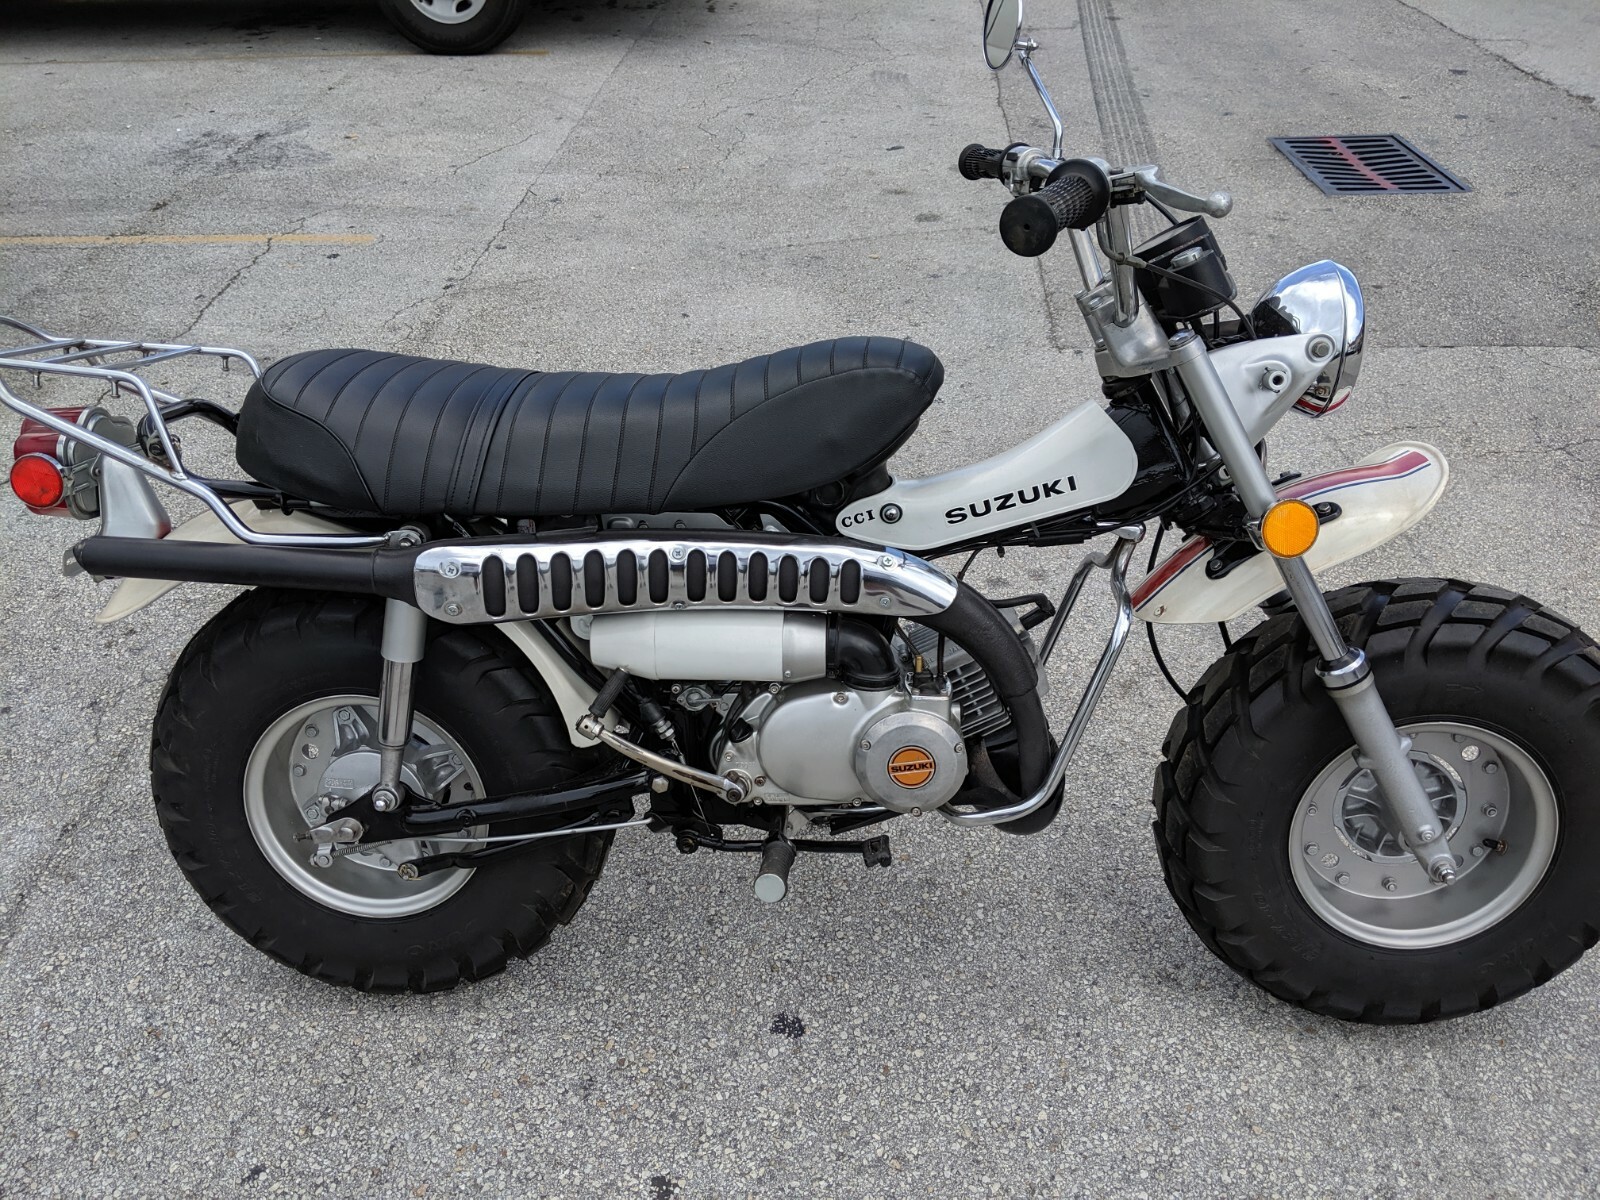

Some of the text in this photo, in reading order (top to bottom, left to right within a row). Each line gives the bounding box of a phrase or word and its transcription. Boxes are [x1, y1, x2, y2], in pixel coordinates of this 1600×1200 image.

[945, 475, 1078, 525] SUZUKI
[841, 509, 876, 528] CCI
[890, 762, 933, 773] SUZUKI
